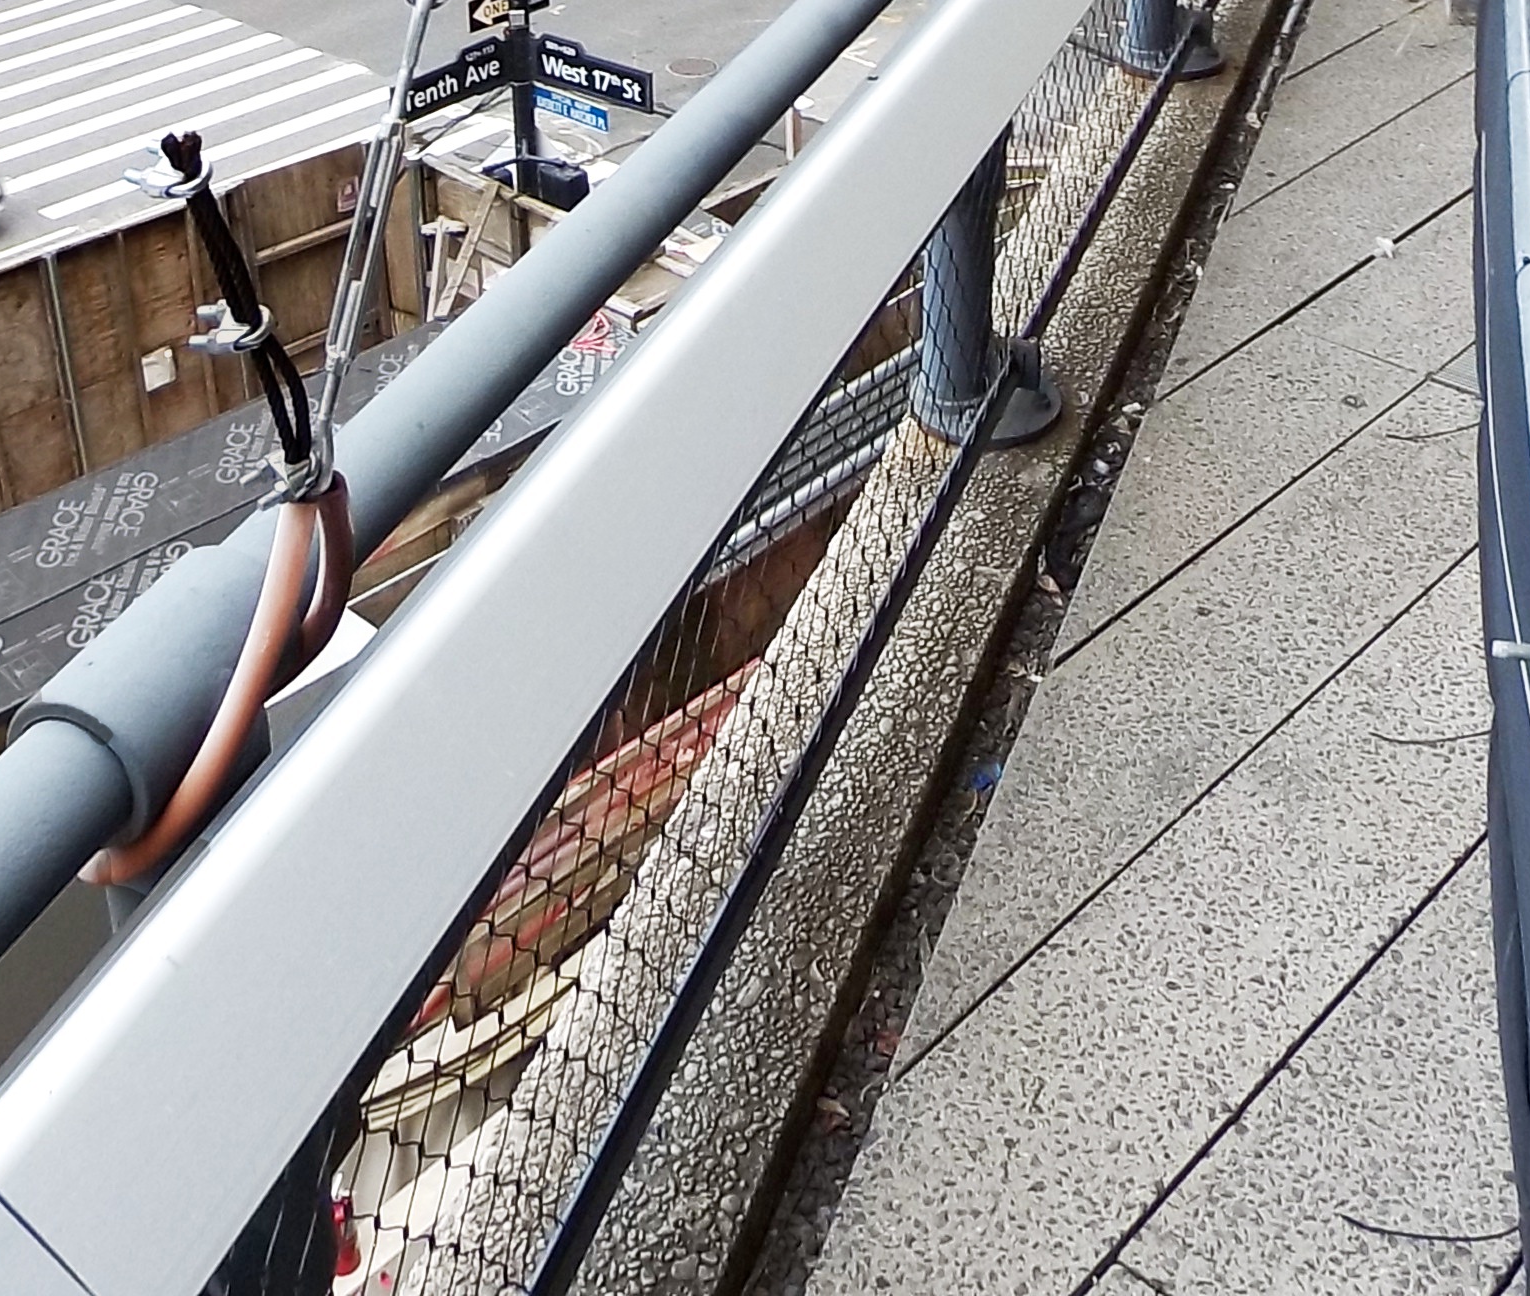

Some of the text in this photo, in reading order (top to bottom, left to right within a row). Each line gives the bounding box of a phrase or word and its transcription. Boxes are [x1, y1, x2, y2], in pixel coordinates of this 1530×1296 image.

[483, 0, 509, 18] ONE
[406, 60, 501, 112] Tenth Ave
[541, 54, 642, 102] West 17th St
[555, 347, 583, 396] GRAC
[215, 422, 256, 485] GRACE
[113, 472, 159, 537] GRACE
[35, 499, 86, 568] GRACE
[66, 573, 117, 648] GRACE
